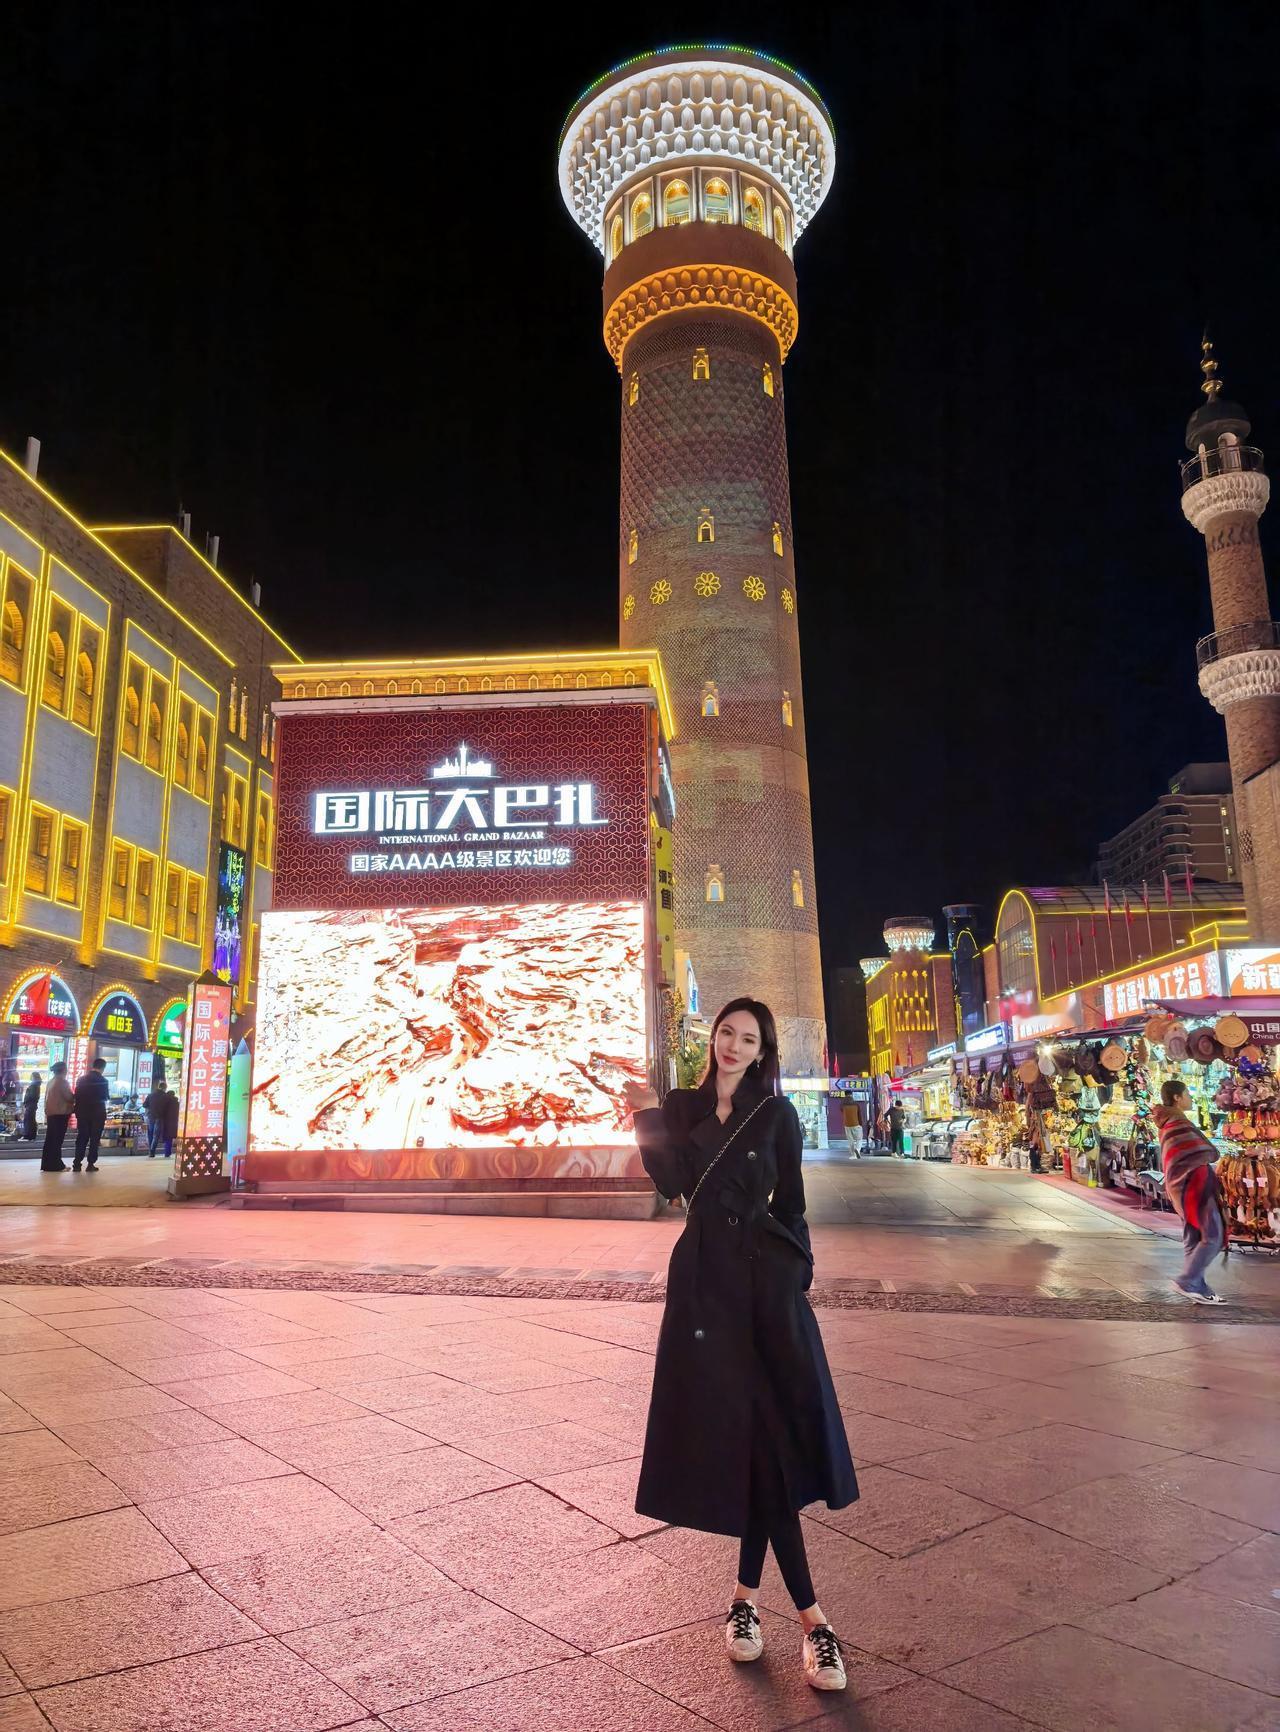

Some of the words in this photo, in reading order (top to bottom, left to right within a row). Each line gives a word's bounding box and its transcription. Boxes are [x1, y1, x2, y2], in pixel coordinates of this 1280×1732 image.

[314, 783, 609, 833] 国际大巴扎
[350, 848, 571, 873] 国家AAAA级景区欢迎您
[379, 834, 460, 845] INTERNATIONAL
[464, 832, 500, 841] GRAND
[503, 830, 545, 840] BAZAAR
[1116, 963, 1203, 1015] 新疆礼物工艺品
[189, 1000, 213, 1111] 国际大巴扎
[1252, 1033, 1274, 1041] China
[206, 1039, 229, 1137] 演艺售票
